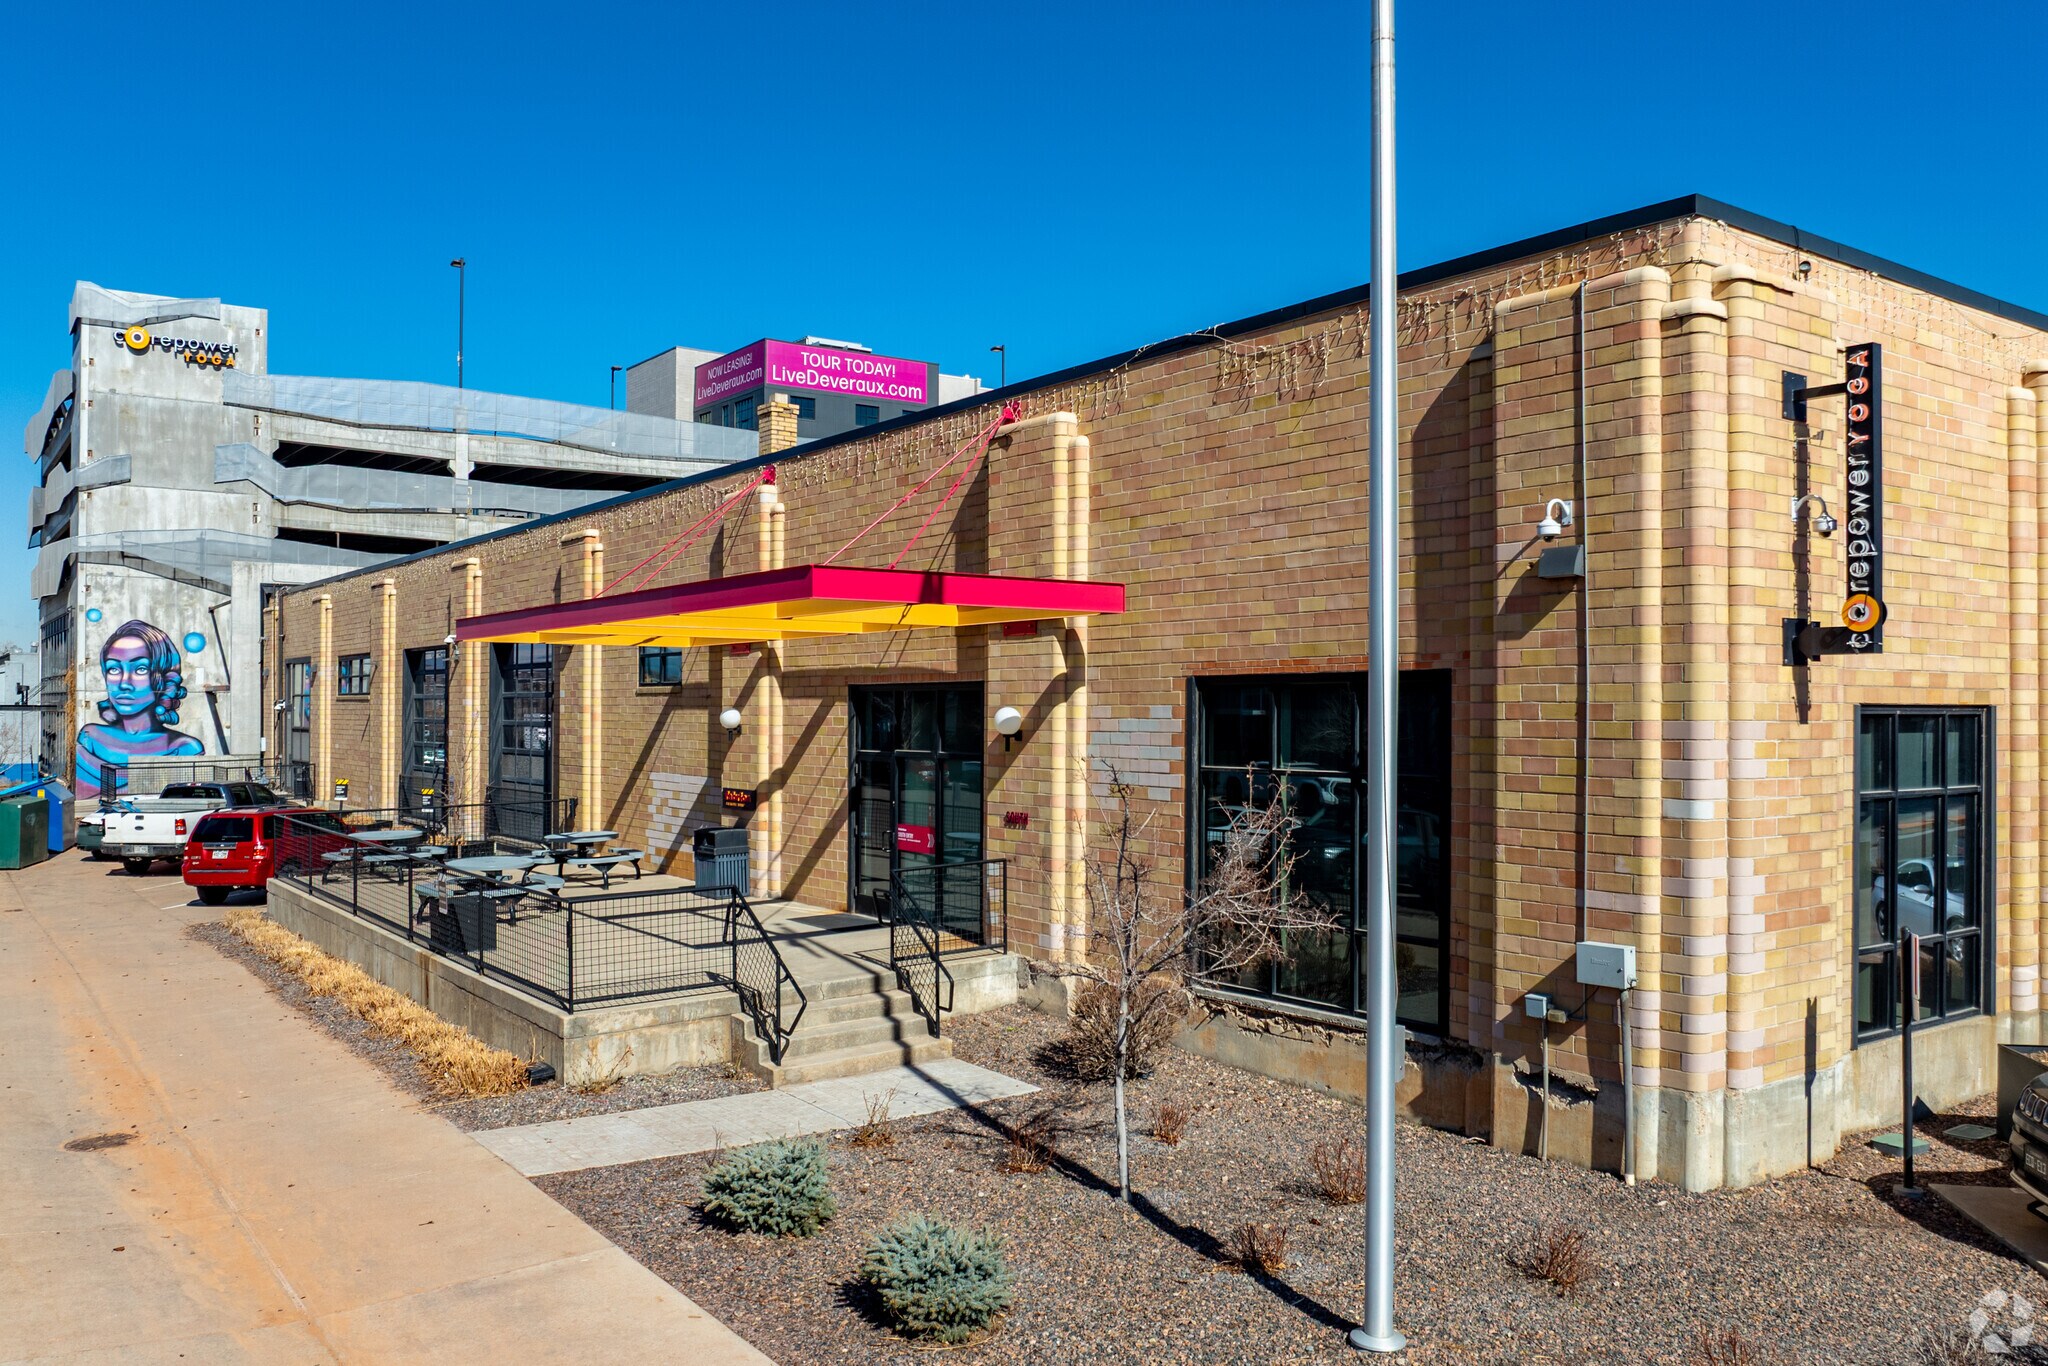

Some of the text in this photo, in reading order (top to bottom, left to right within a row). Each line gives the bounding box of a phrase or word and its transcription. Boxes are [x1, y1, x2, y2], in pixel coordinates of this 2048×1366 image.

[114, 326, 238, 352] corepower
[184, 352, 236, 367] YOGA
[707, 352, 753, 380] NOW LEASING!
[801, 352, 896, 378] TOUR TODAY!
[697, 366, 763, 401] LiveDeveraux.com
[772, 364, 923, 400] LiveDeveraux.com
[1842, 350, 1880, 649] corepower YOGA
[1005, 811, 1029, 826] SOUTH
